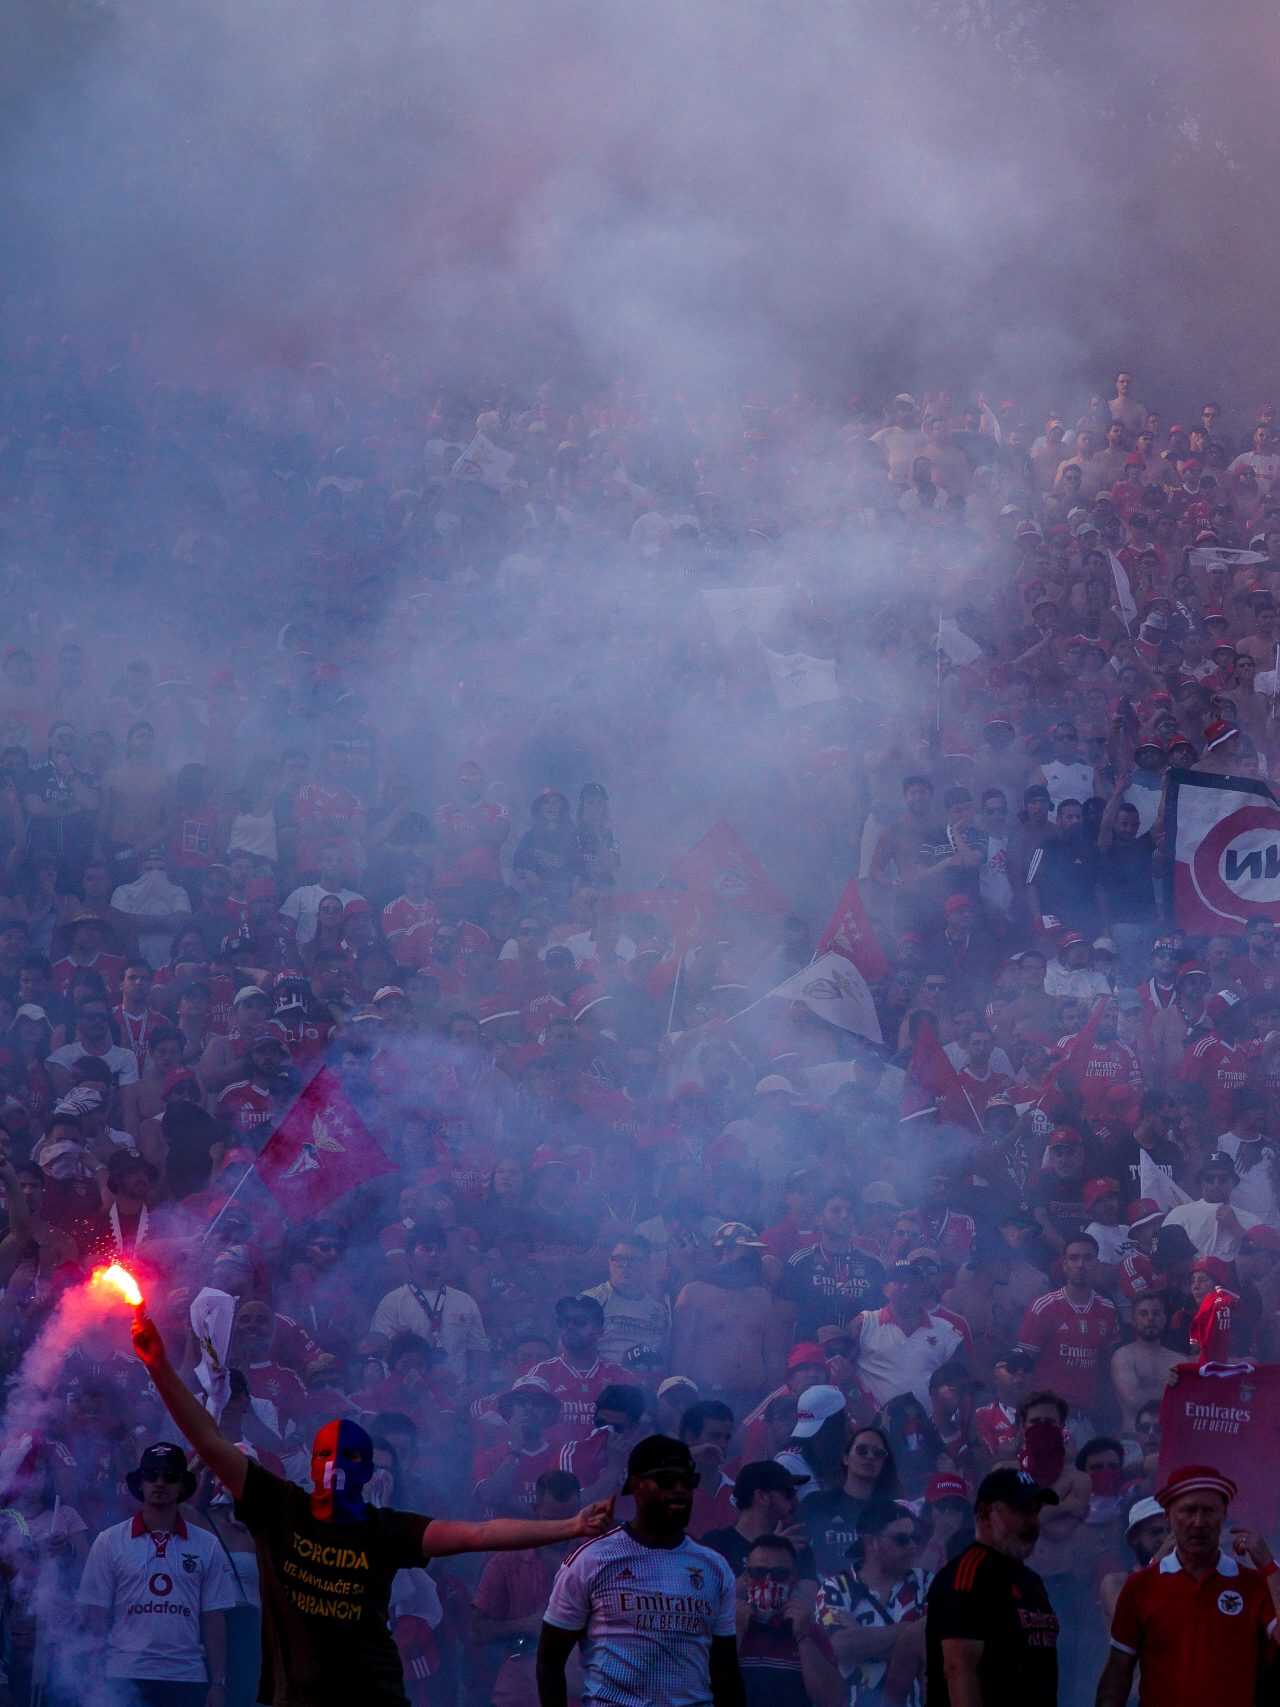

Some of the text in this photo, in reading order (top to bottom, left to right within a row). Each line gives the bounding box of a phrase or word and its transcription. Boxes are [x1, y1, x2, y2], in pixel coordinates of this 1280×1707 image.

[1184, 1401, 1250, 1422] Emirates
[293, 1532, 369, 1570] TORCIDA
[128, 1601, 193, 1617] vodafone
[619, 1592, 713, 1615] Emirates
